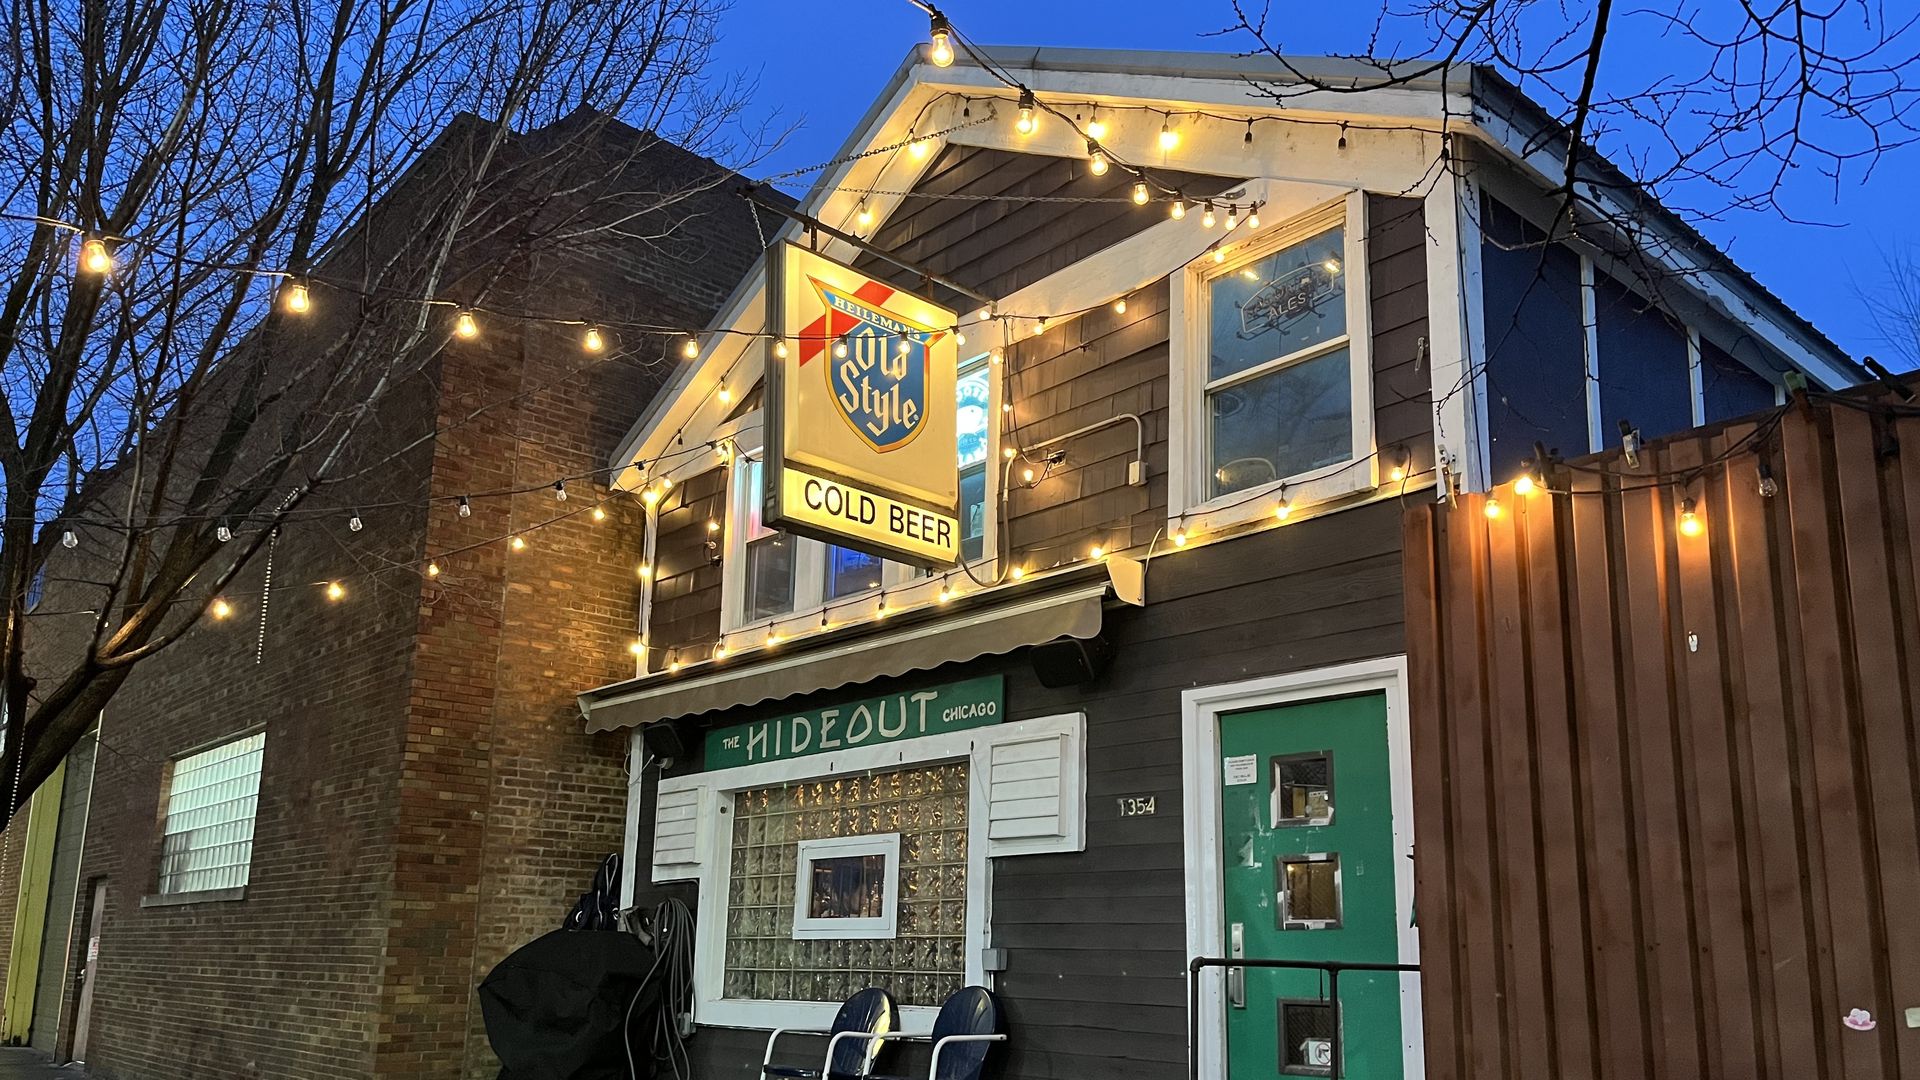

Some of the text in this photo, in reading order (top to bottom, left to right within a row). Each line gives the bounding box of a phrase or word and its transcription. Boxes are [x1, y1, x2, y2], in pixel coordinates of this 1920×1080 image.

[1269, 292, 1306, 320] ALES
[855, 326, 907, 381] Old
[839, 360, 917, 437] Style
[804, 479, 951, 548] COLD BEER
[723, 691, 996, 761] THE HIDEOUT CHICAGO
[1119, 796, 1155, 817] 1354
